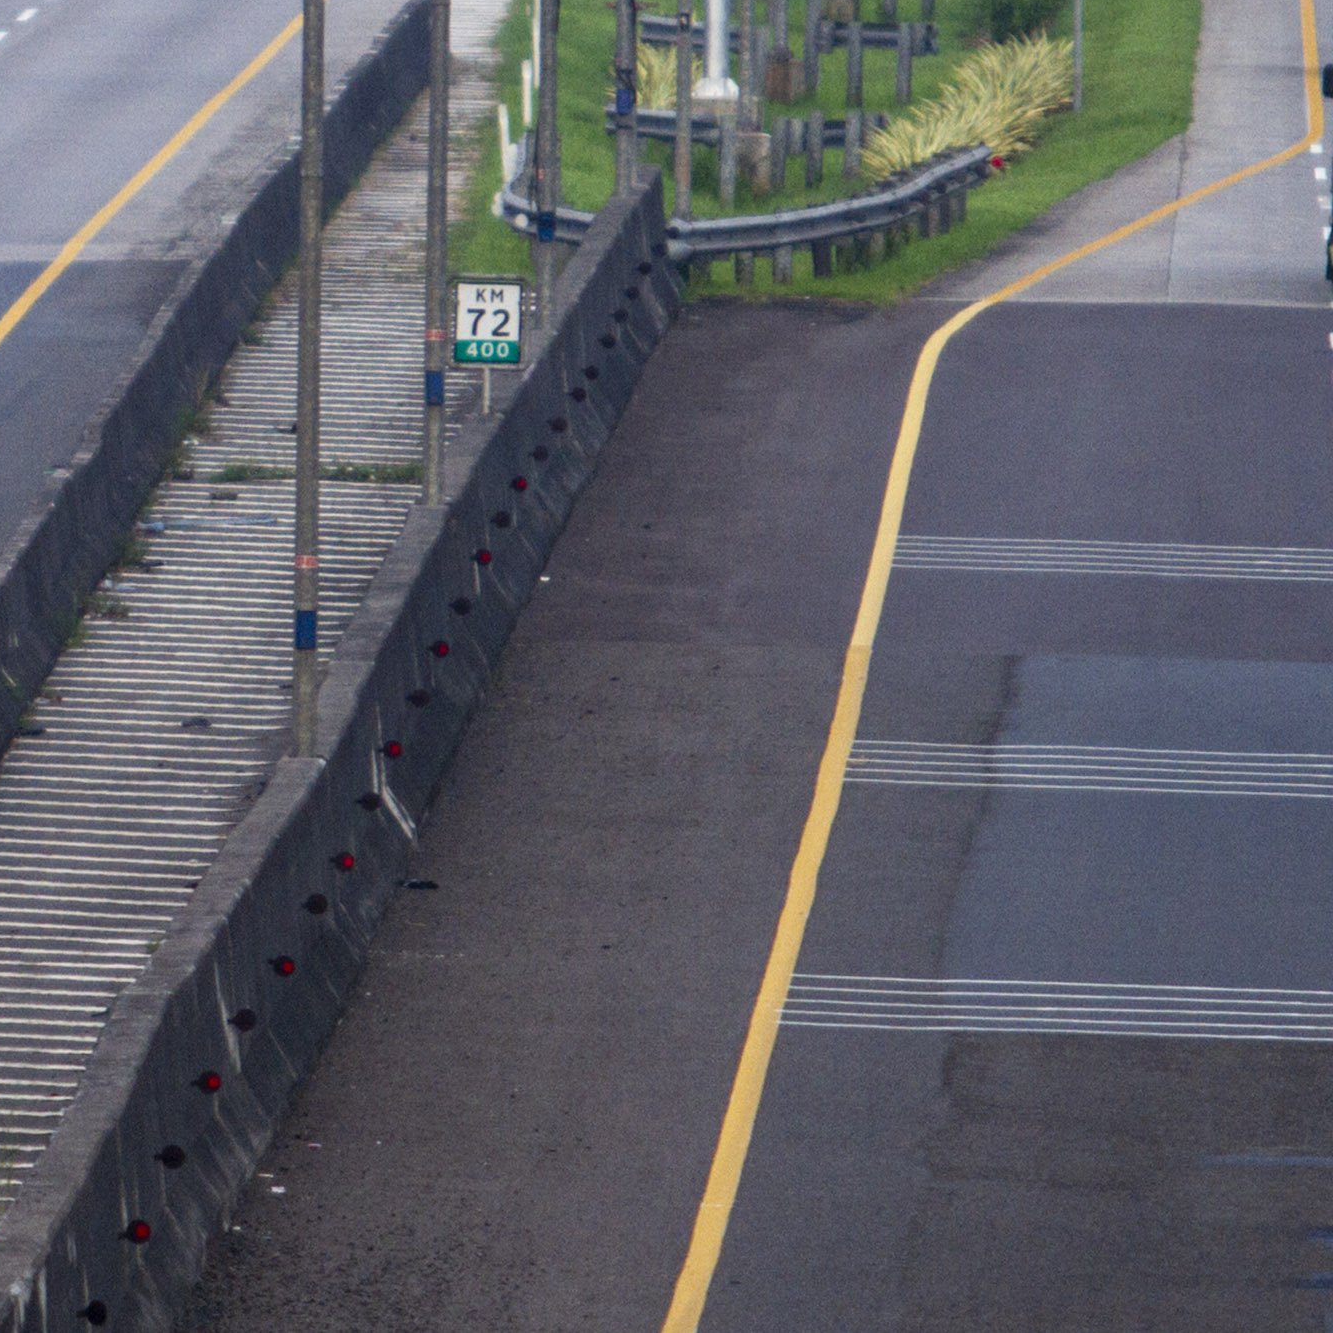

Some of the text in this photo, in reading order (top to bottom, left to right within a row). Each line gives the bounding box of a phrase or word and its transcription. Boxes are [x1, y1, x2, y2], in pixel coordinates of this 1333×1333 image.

[475, 288, 505, 304] KM
[466, 308, 511, 337] 72
[466, 342, 510, 358] 400
